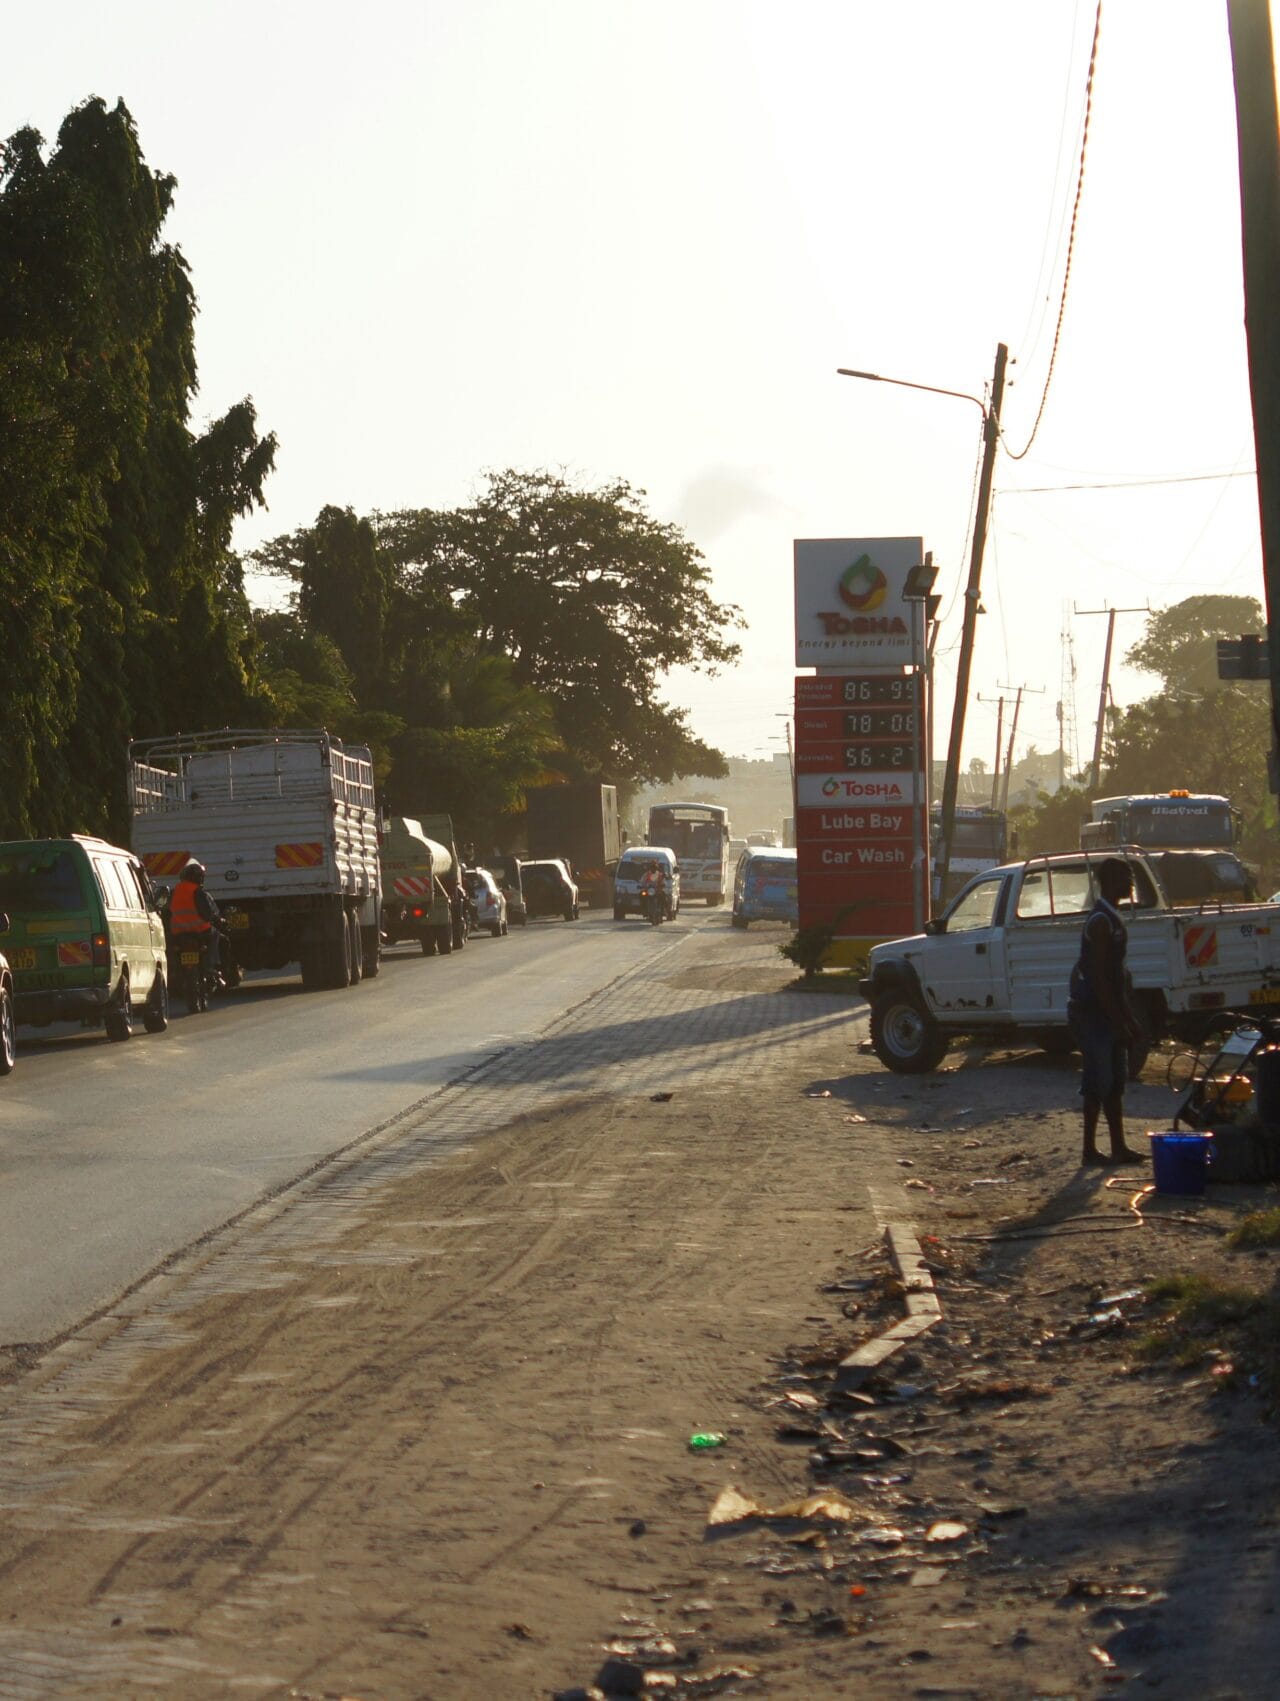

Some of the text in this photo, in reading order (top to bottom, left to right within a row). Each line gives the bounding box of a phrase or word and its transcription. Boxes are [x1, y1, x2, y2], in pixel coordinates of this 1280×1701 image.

[817, 612, 908, 635] TOSHA
[799, 638, 921, 648] Energy beyond limis
[841, 781, 902, 796] TOSHA
[821, 813, 903, 831] Lube Bay
[822, 848, 905, 864] Car Wash
